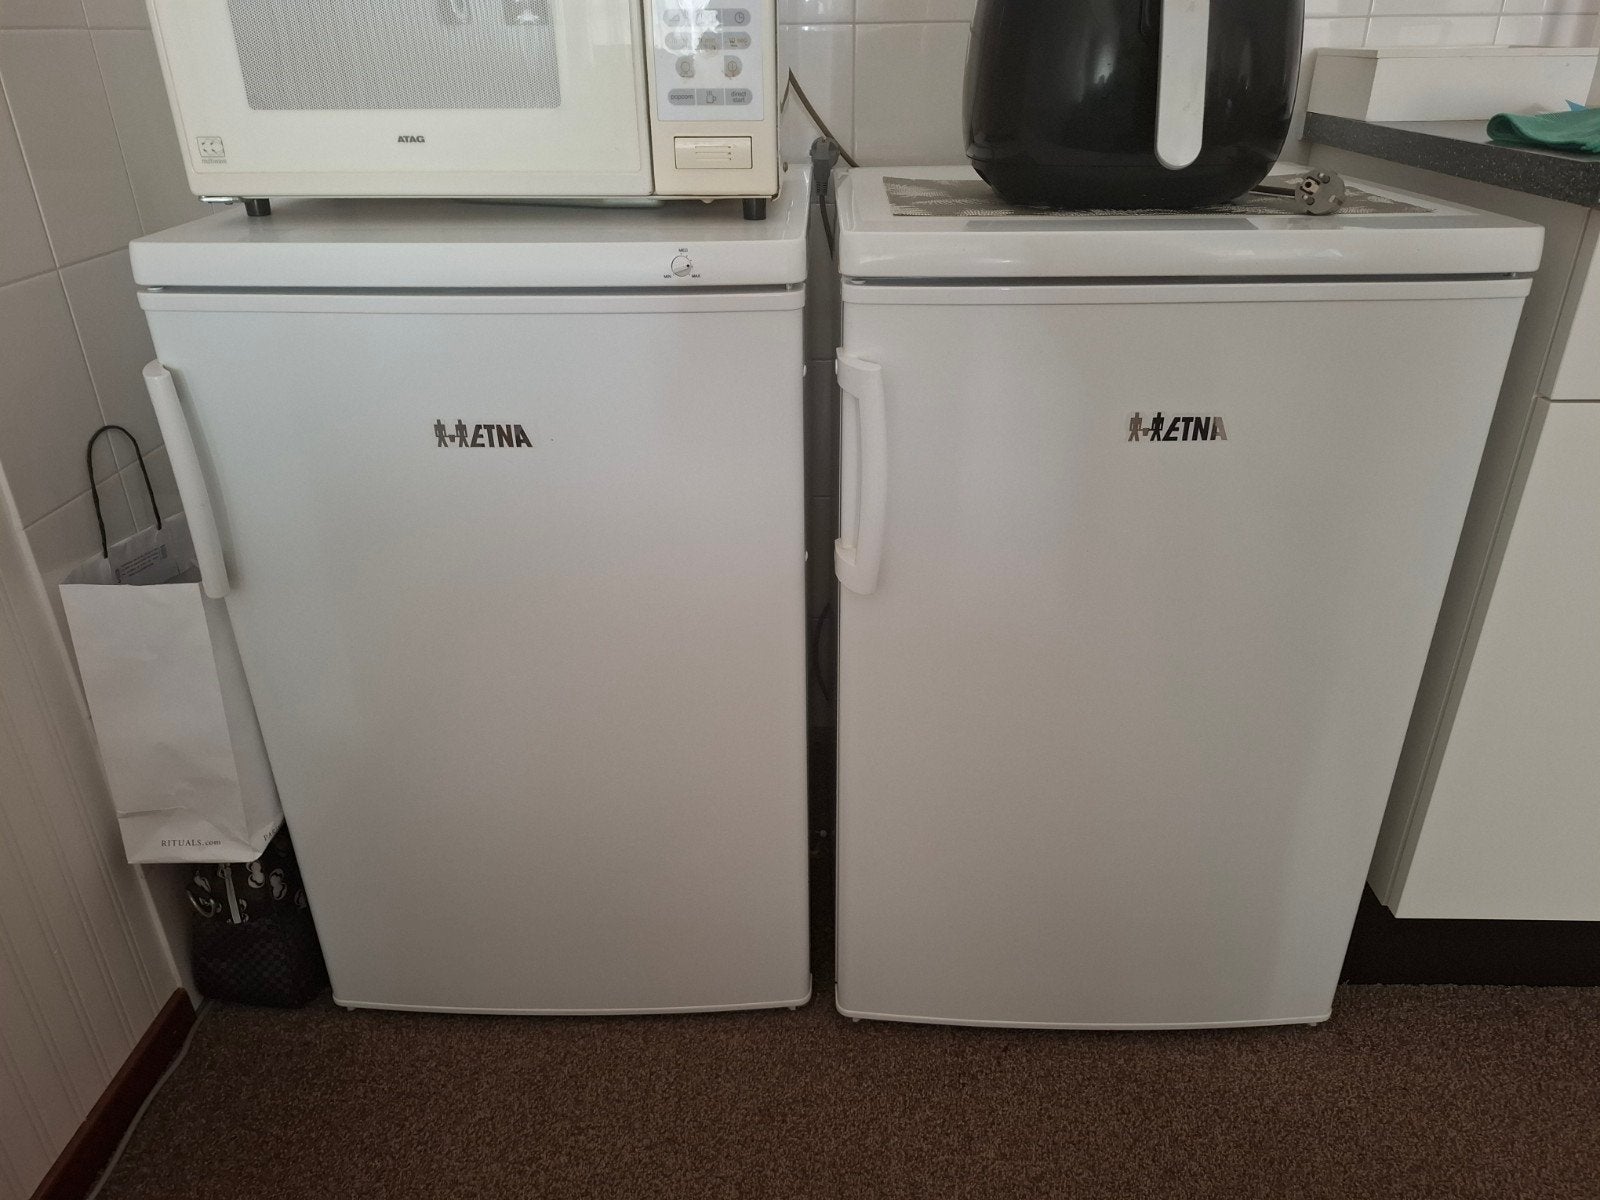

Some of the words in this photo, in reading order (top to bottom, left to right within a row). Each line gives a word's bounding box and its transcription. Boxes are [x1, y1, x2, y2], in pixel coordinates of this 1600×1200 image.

[397, 135, 425, 143] ATAG
[470, 424, 533, 447] ETNA
[1162, 416, 1228, 441] ETNA
[161, 839, 222, 847] RITUALS.com
